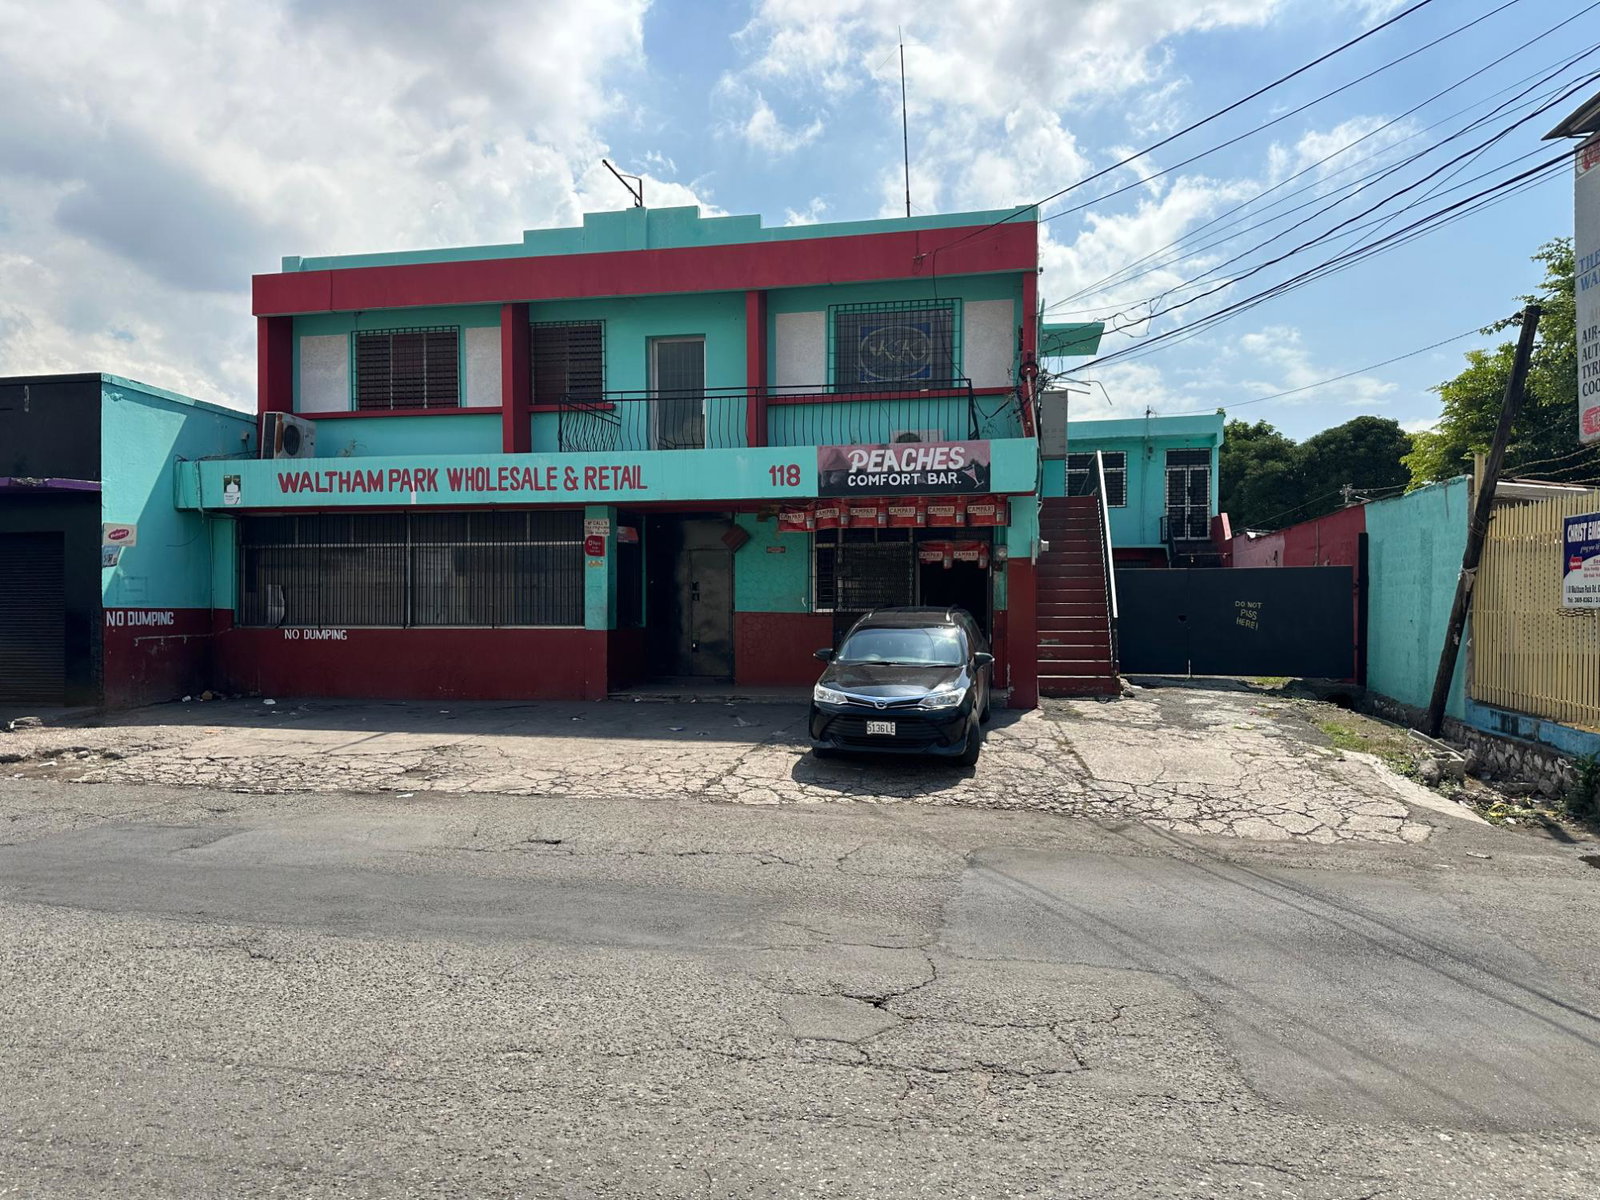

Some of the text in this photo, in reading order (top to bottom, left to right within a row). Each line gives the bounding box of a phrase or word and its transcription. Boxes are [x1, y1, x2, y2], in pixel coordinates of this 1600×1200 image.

[1582, 342, 1600, 361] AUT
[848, 446, 965, 473] PEACHES
[277, 465, 648, 493] WALTHAM PARK WHOLESALE & RETAIL
[768, 463, 801, 487] 118
[848, 471, 962, 486] COMFORT BAR.
[889, 507, 915, 515] CAMPARI
[928, 506, 954, 514] CAMPARI
[967, 505, 994, 513] CAMPARI
[1247, 601, 1263, 609] NOT
[106, 611, 174, 627] NO DUMPING
[1240, 609, 1258, 620] PISS
[284, 629, 347, 640] NO DUMPING
